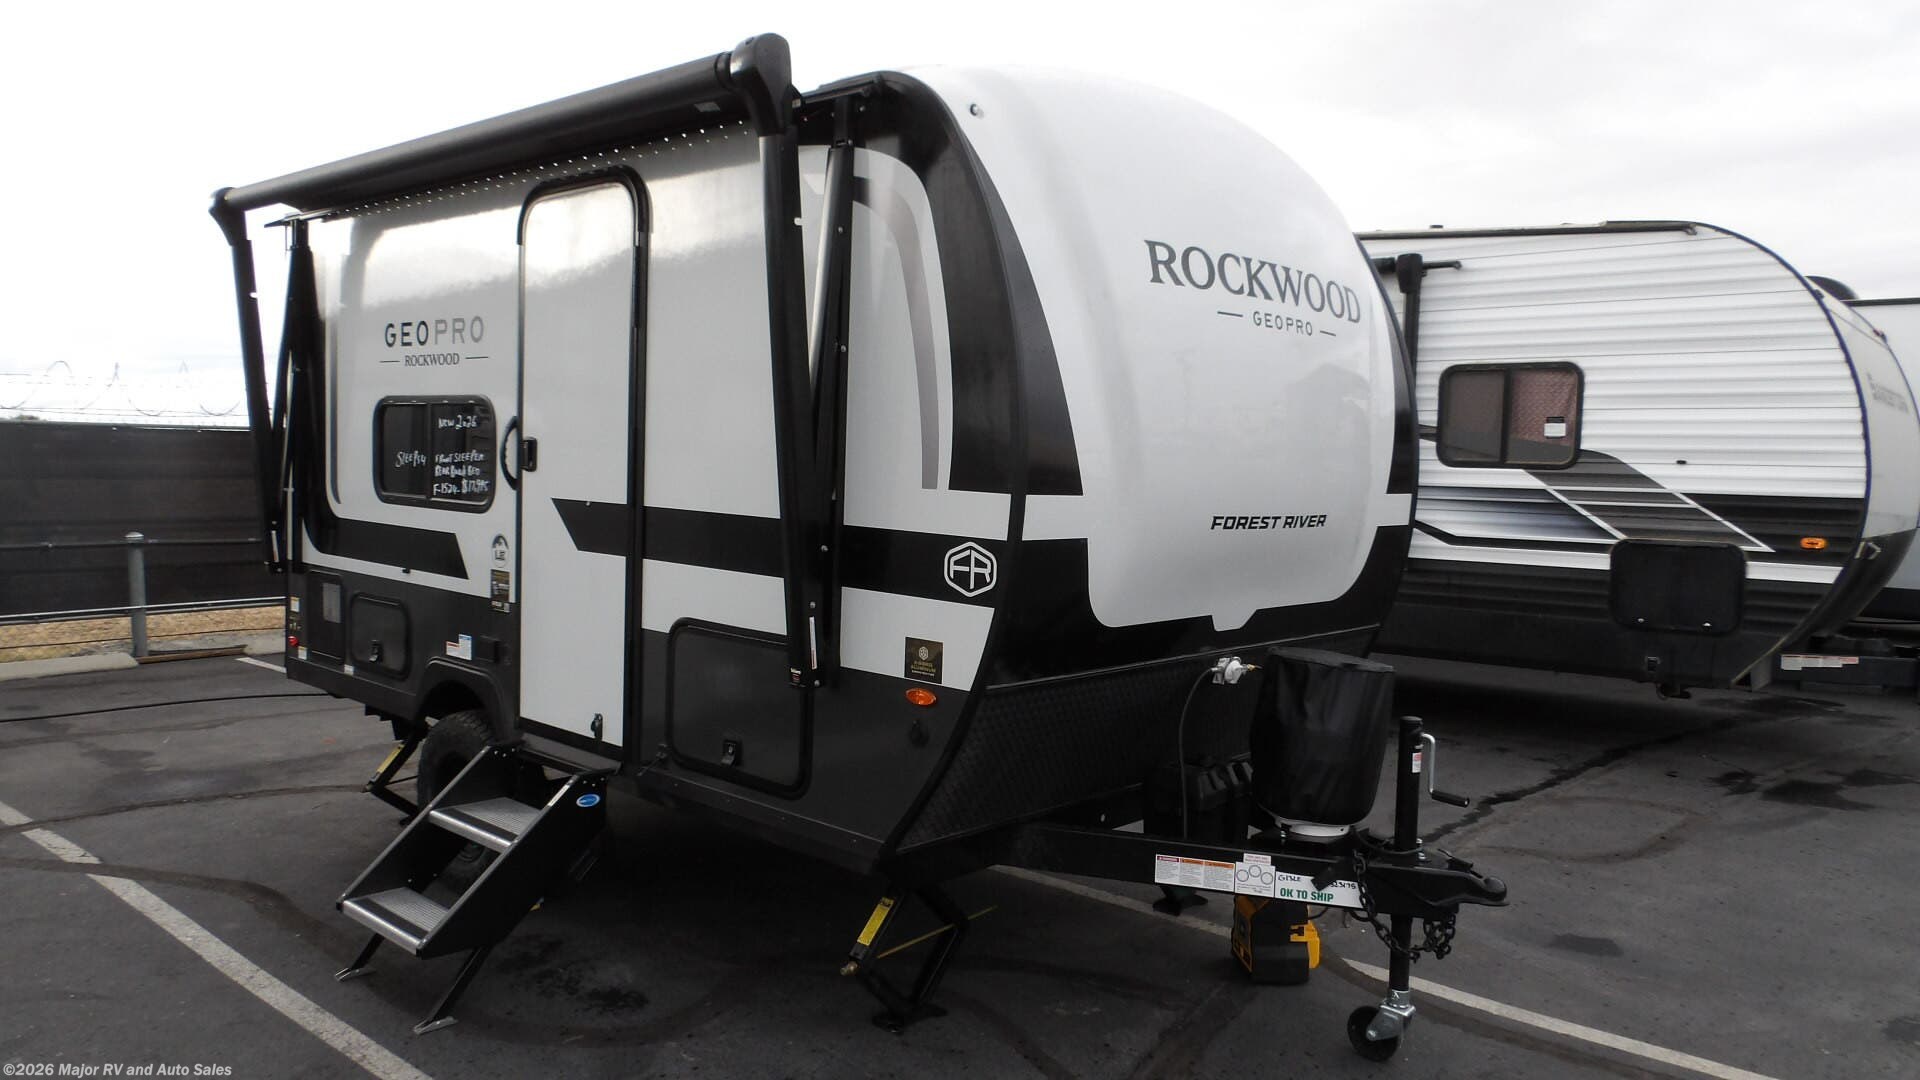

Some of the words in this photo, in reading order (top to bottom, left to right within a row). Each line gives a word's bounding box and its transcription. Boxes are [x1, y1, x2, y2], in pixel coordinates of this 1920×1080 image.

[1144, 239, 1361, 323] ROCKWOOD
[404, 352, 460, 367] ROCKWOOD
[1210, 516, 1281, 530] FOREST
[1282, 514, 1328, 529] RIVER
[1280, 887, 1294, 898] OK
[1296, 889, 1308, 899] TO
[1310, 891, 1334, 903] SHIP
